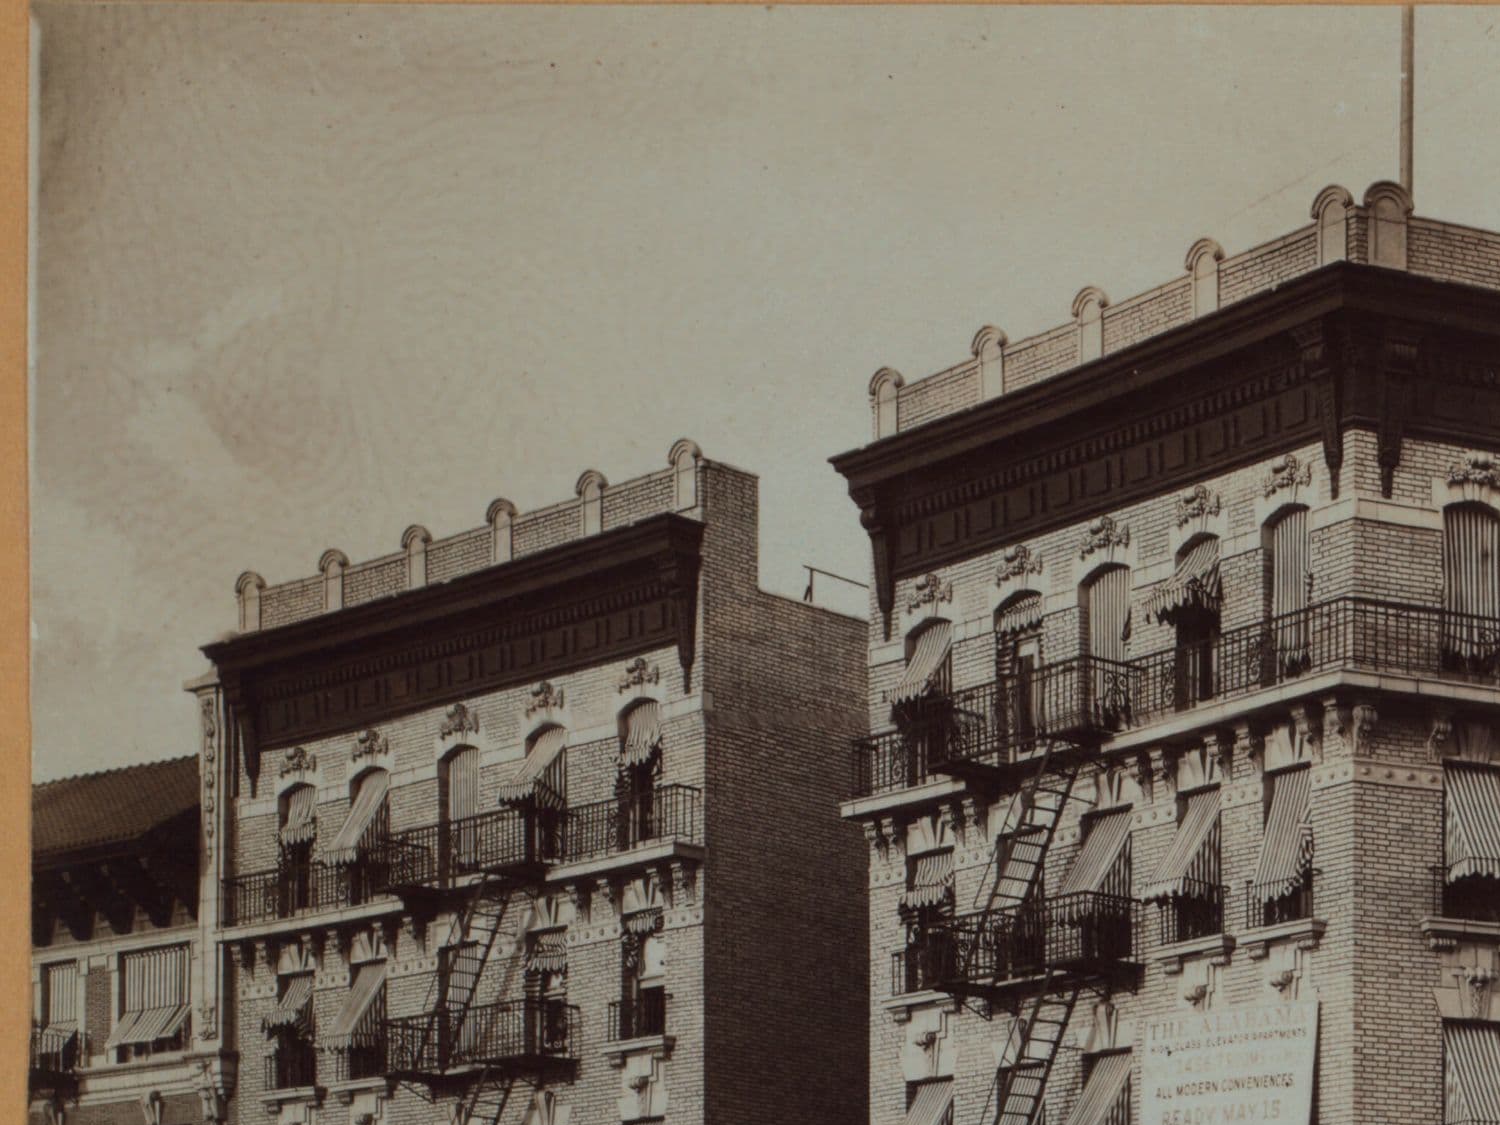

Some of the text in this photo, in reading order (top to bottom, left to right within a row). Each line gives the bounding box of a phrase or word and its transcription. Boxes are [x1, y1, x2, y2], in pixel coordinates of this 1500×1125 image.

[1156, 1087, 1172, 1100] ALL
[1176, 1079, 1219, 1097] MODERN
[1222, 1101, 1259, 1122] MAY
